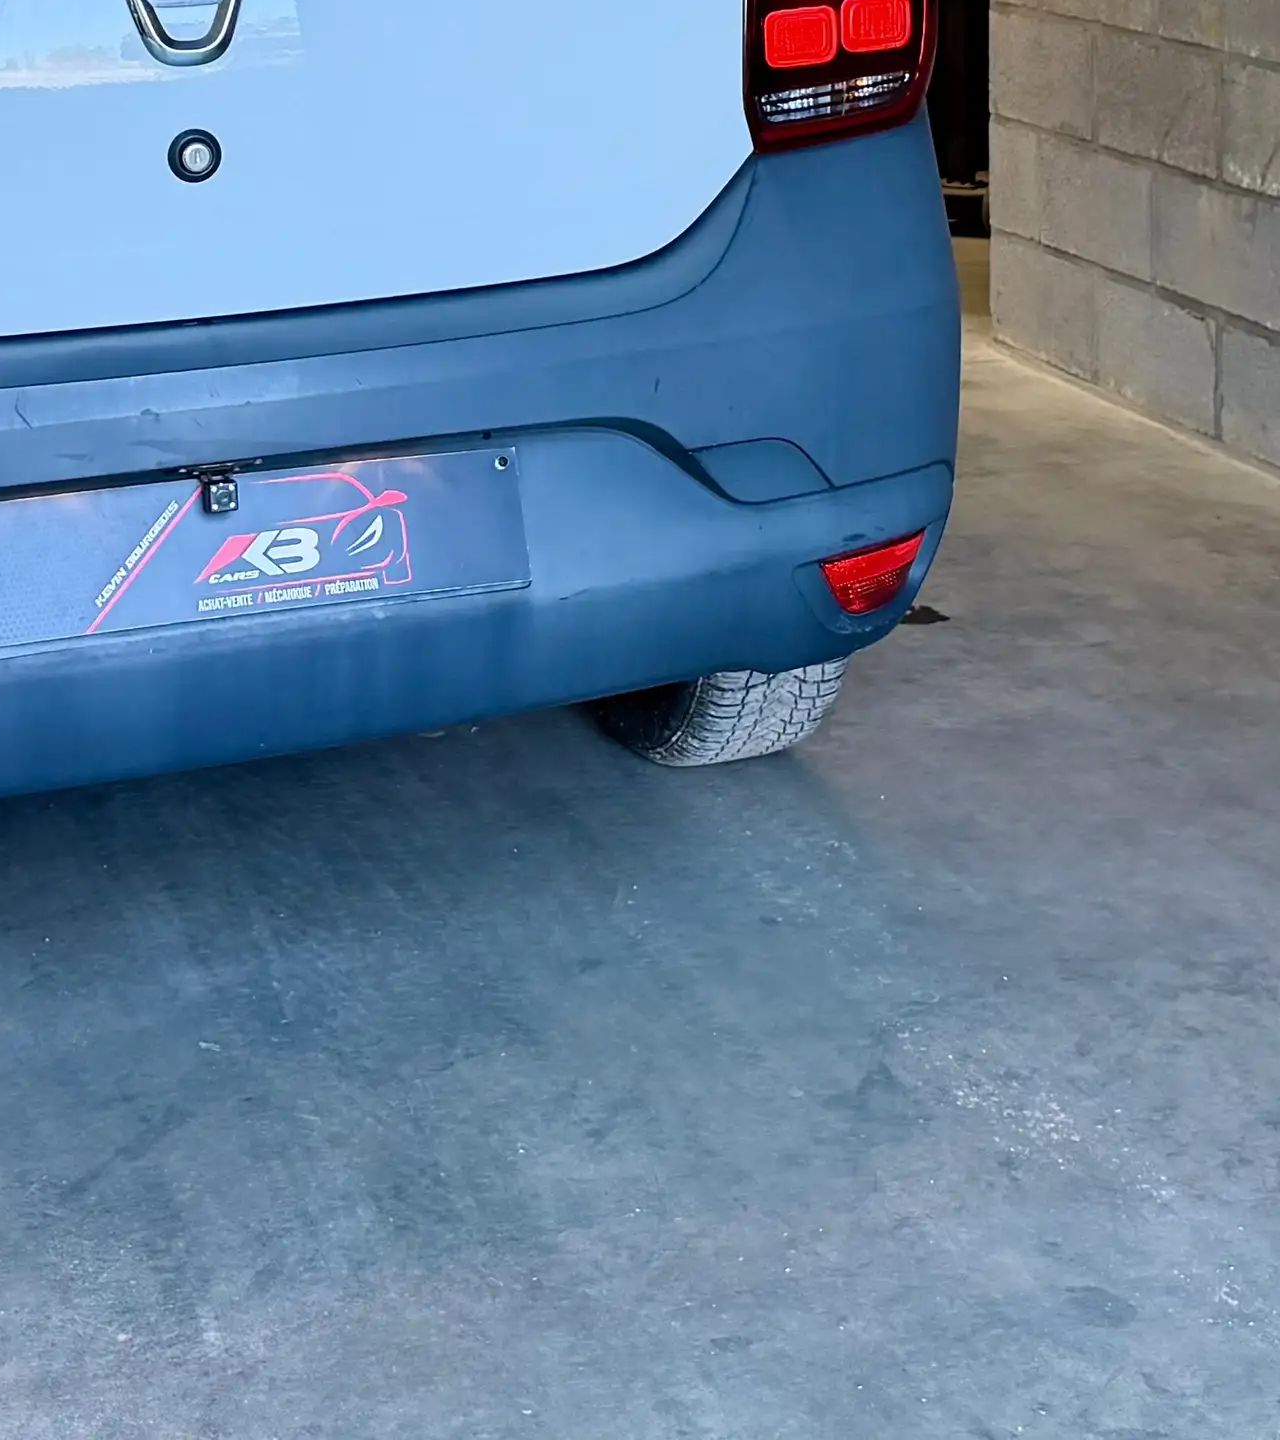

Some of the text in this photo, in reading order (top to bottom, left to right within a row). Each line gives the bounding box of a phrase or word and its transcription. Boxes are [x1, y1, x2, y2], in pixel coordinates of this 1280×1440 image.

[94, 499, 180, 608] KEVIN BOURGEOIS
[193, 527, 321, 584] KB
[208, 568, 261, 585] CARS
[197, 592, 254, 613] ACHAT-VENTE
[323, 576, 380, 597] PRÉPARATION
